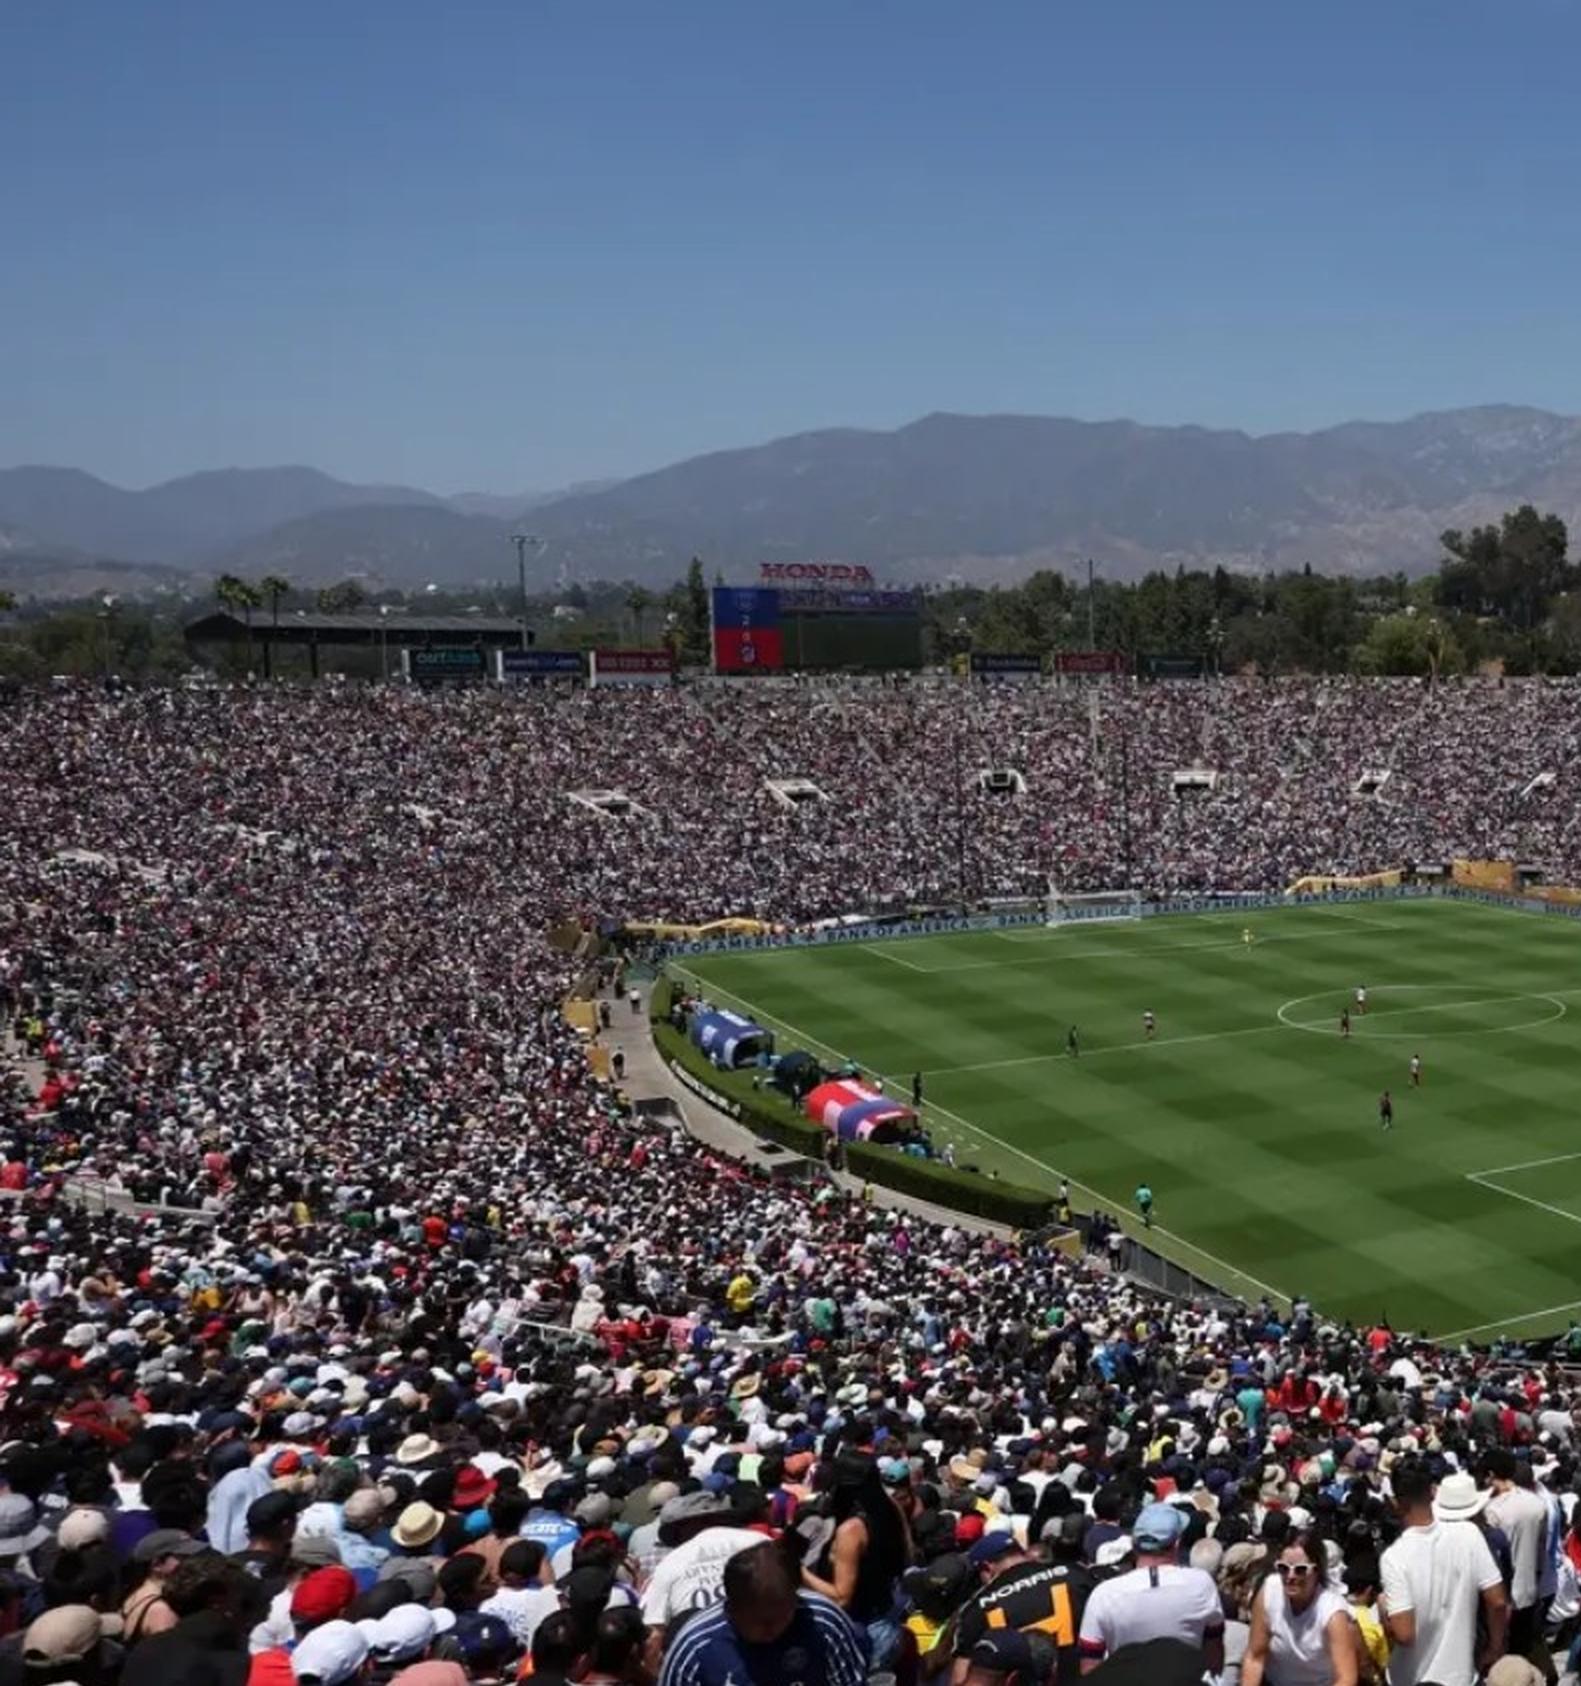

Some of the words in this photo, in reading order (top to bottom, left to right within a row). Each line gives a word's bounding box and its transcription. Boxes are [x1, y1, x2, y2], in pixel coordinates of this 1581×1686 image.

[759, 563, 872, 581] HONDA
[827, 928, 869, 942] BANK
[900, 918, 969, 935] AMERICA
[979, 1565, 1069, 1608] NORRIS
